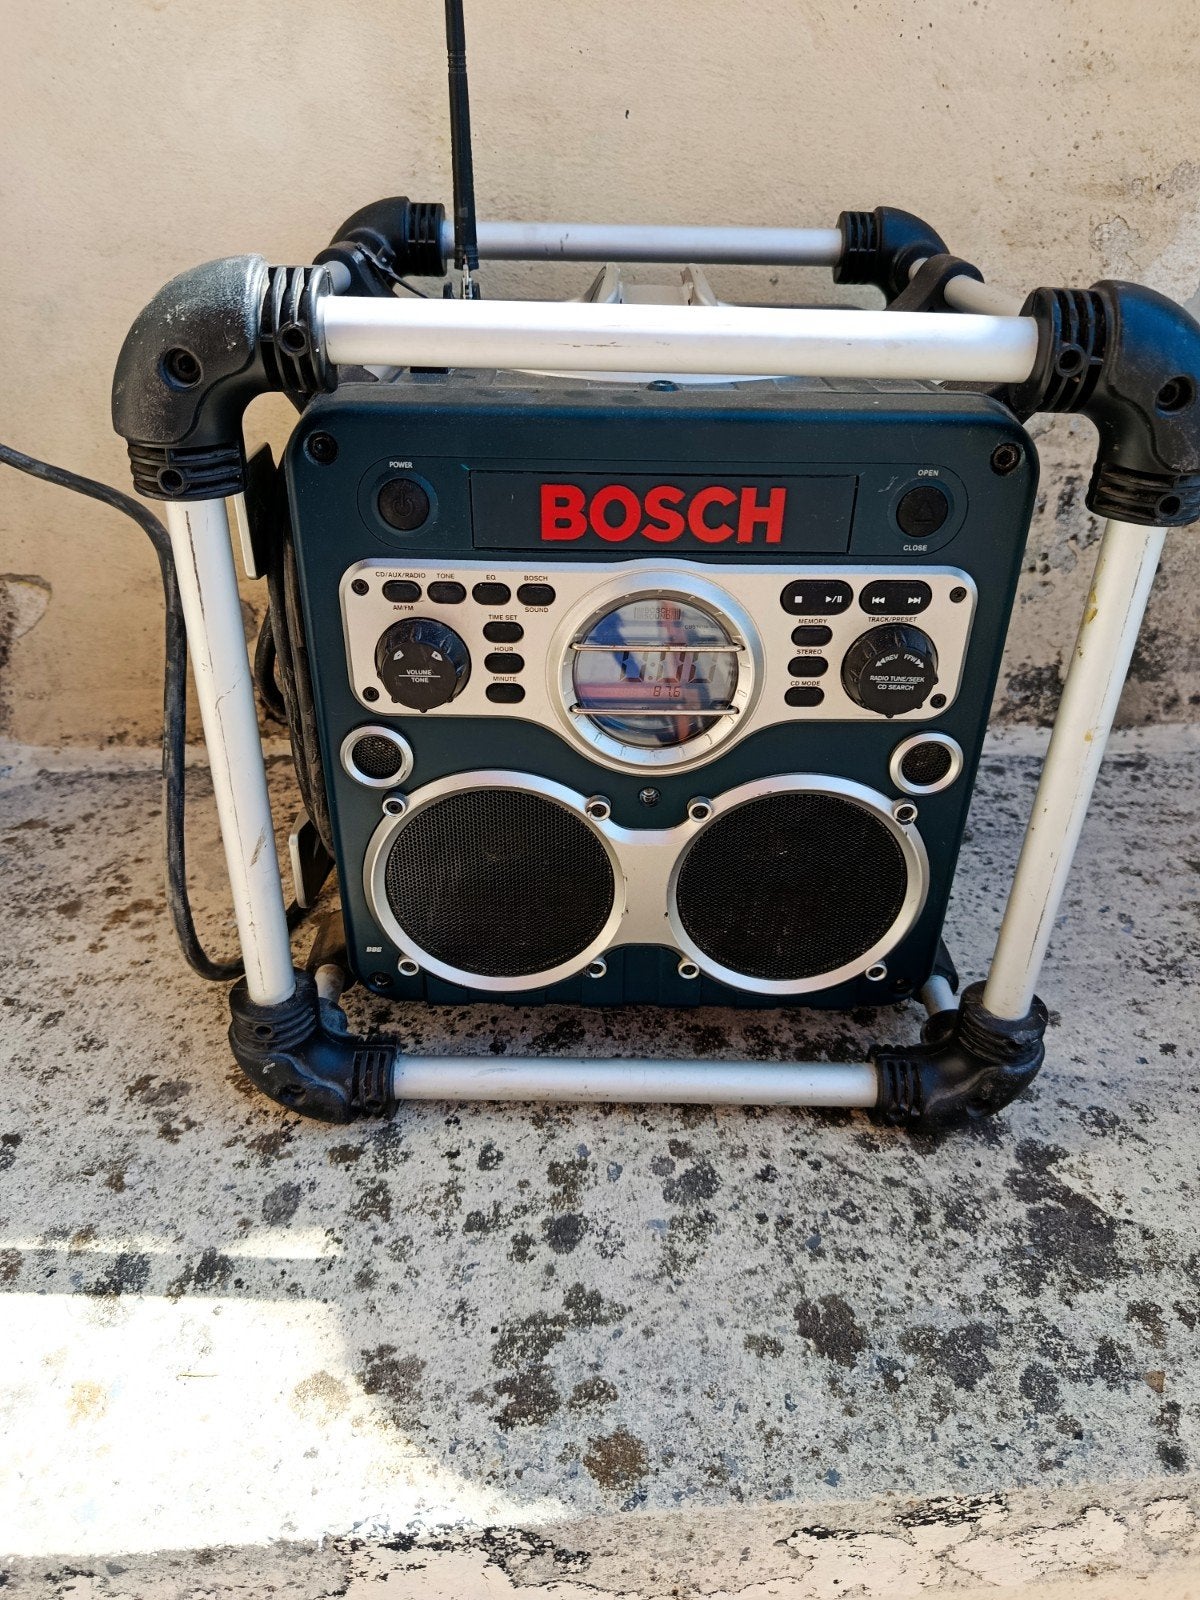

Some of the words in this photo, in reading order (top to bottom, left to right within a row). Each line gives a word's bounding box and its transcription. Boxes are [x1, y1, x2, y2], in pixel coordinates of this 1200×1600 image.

[389, 461, 413, 469] POWER
[917, 469, 939, 477] OPEN
[540, 483, 787, 543] BOSCH
[903, 544, 928, 552] CLOSE
[375, 571, 426, 579] CD/AUX/RADIO
[885, 653, 899, 662] REV
[890, 675, 926, 683] TUNE/SEEK
[653, 685, 681, 698] 87.6
